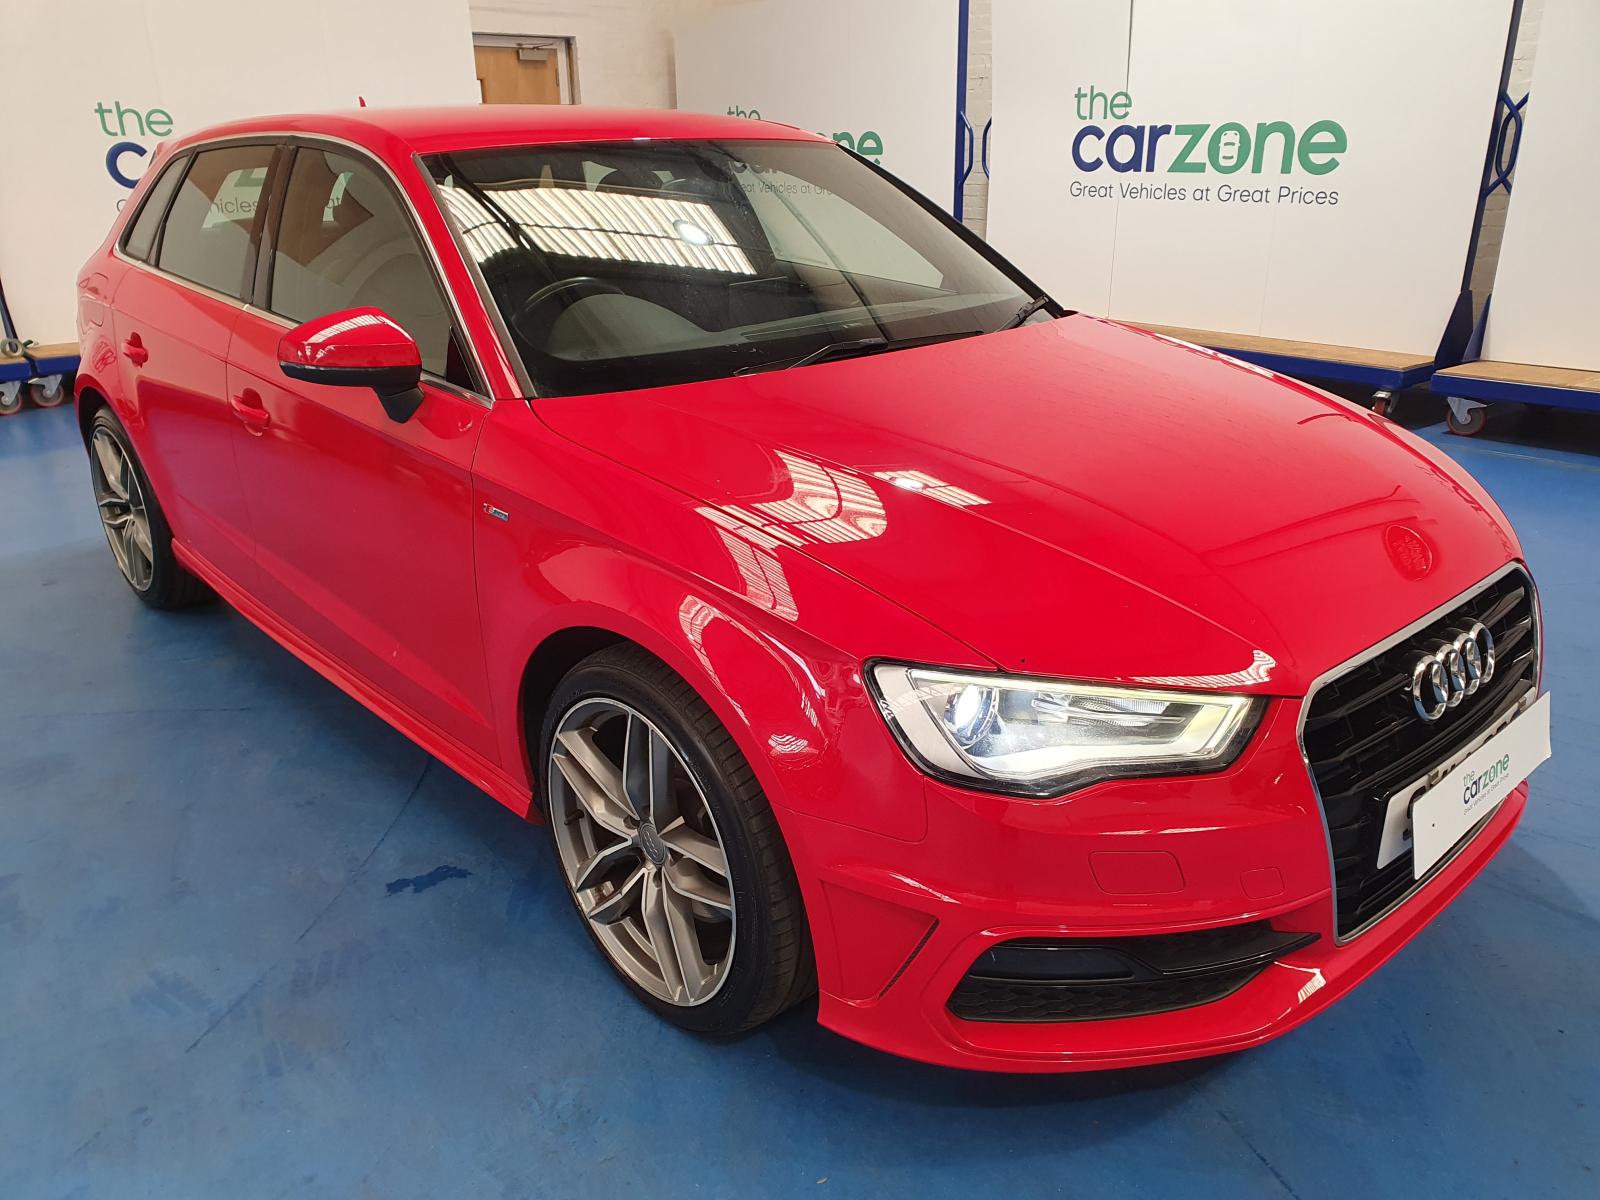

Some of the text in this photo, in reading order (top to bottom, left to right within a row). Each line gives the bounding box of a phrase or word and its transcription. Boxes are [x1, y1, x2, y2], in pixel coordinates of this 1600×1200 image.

[94, 101, 173, 137] the
[1074, 85, 1132, 120] the
[1071, 119, 1348, 176] carzone
[758, 181, 798, 194] Vehicles
[1069, 181, 1339, 205] Great Vehicles at Great Prices
[1463, 753, 1510, 805] carzone
